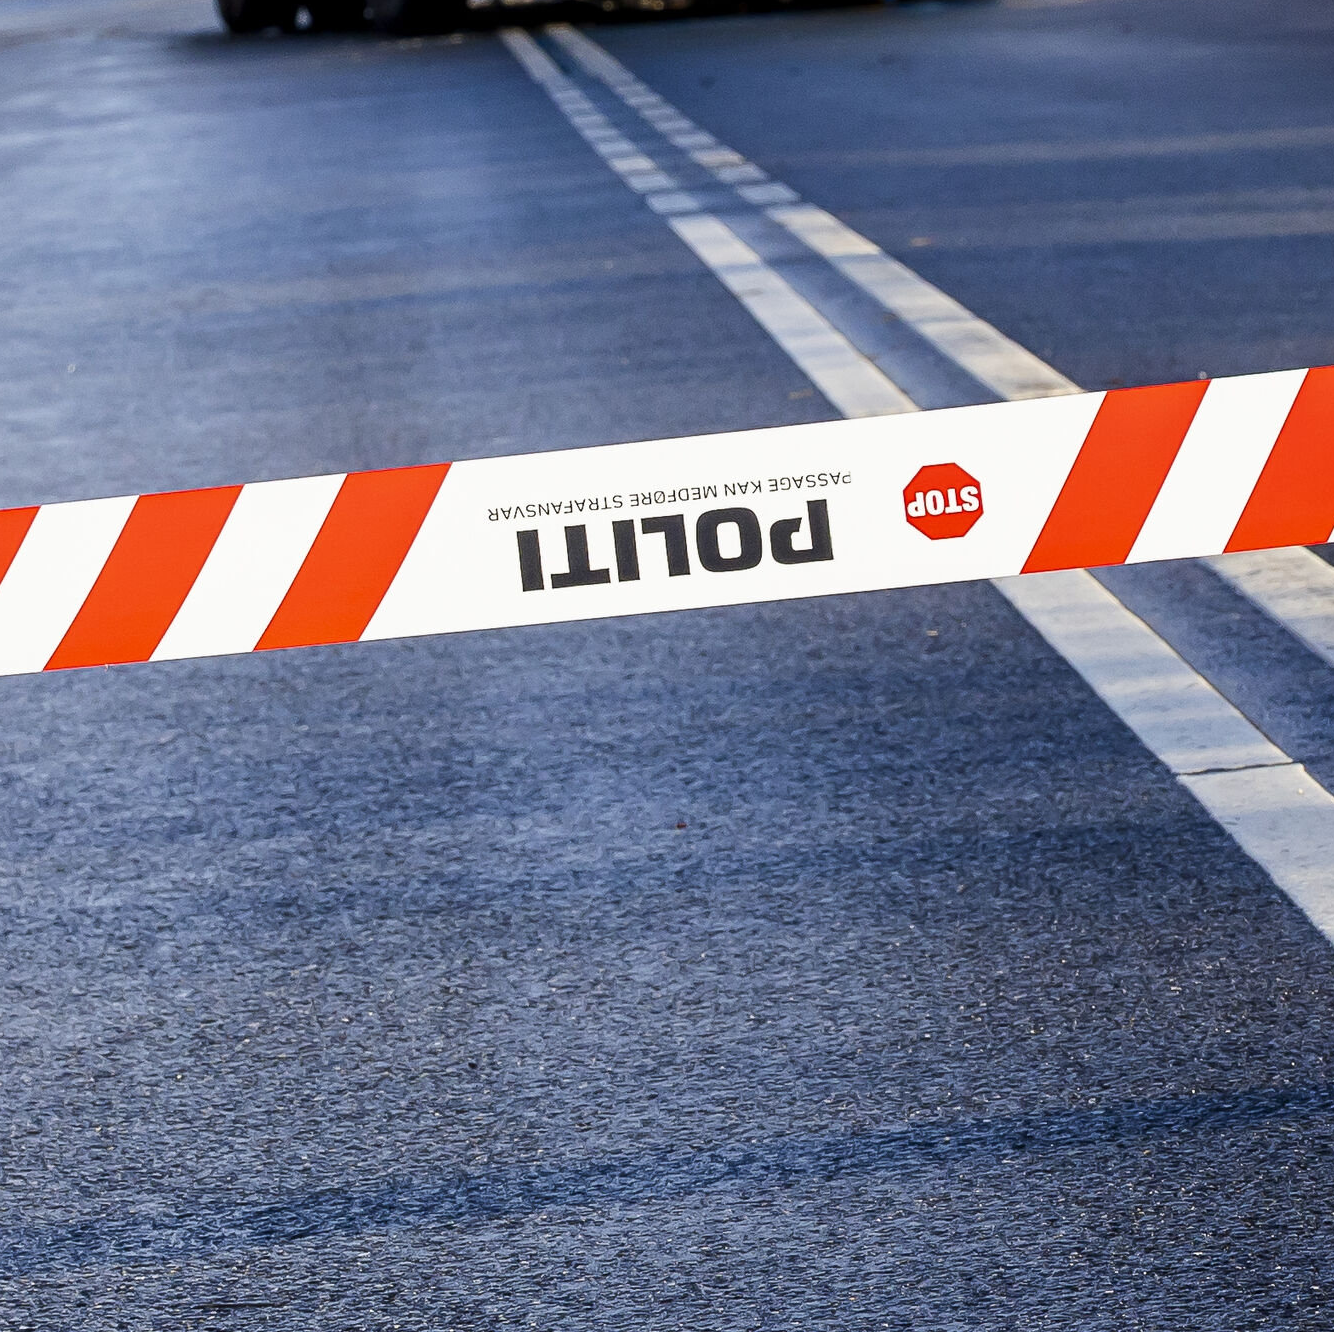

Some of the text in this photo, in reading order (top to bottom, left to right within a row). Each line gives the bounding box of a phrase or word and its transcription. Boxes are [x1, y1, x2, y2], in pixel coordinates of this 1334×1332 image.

[488, 472, 852, 522] PASSAGE KAN MEDFØRE STRAFANSVAR
[908, 486, 980, 518] STOP
[517, 499, 835, 592] POLITI
